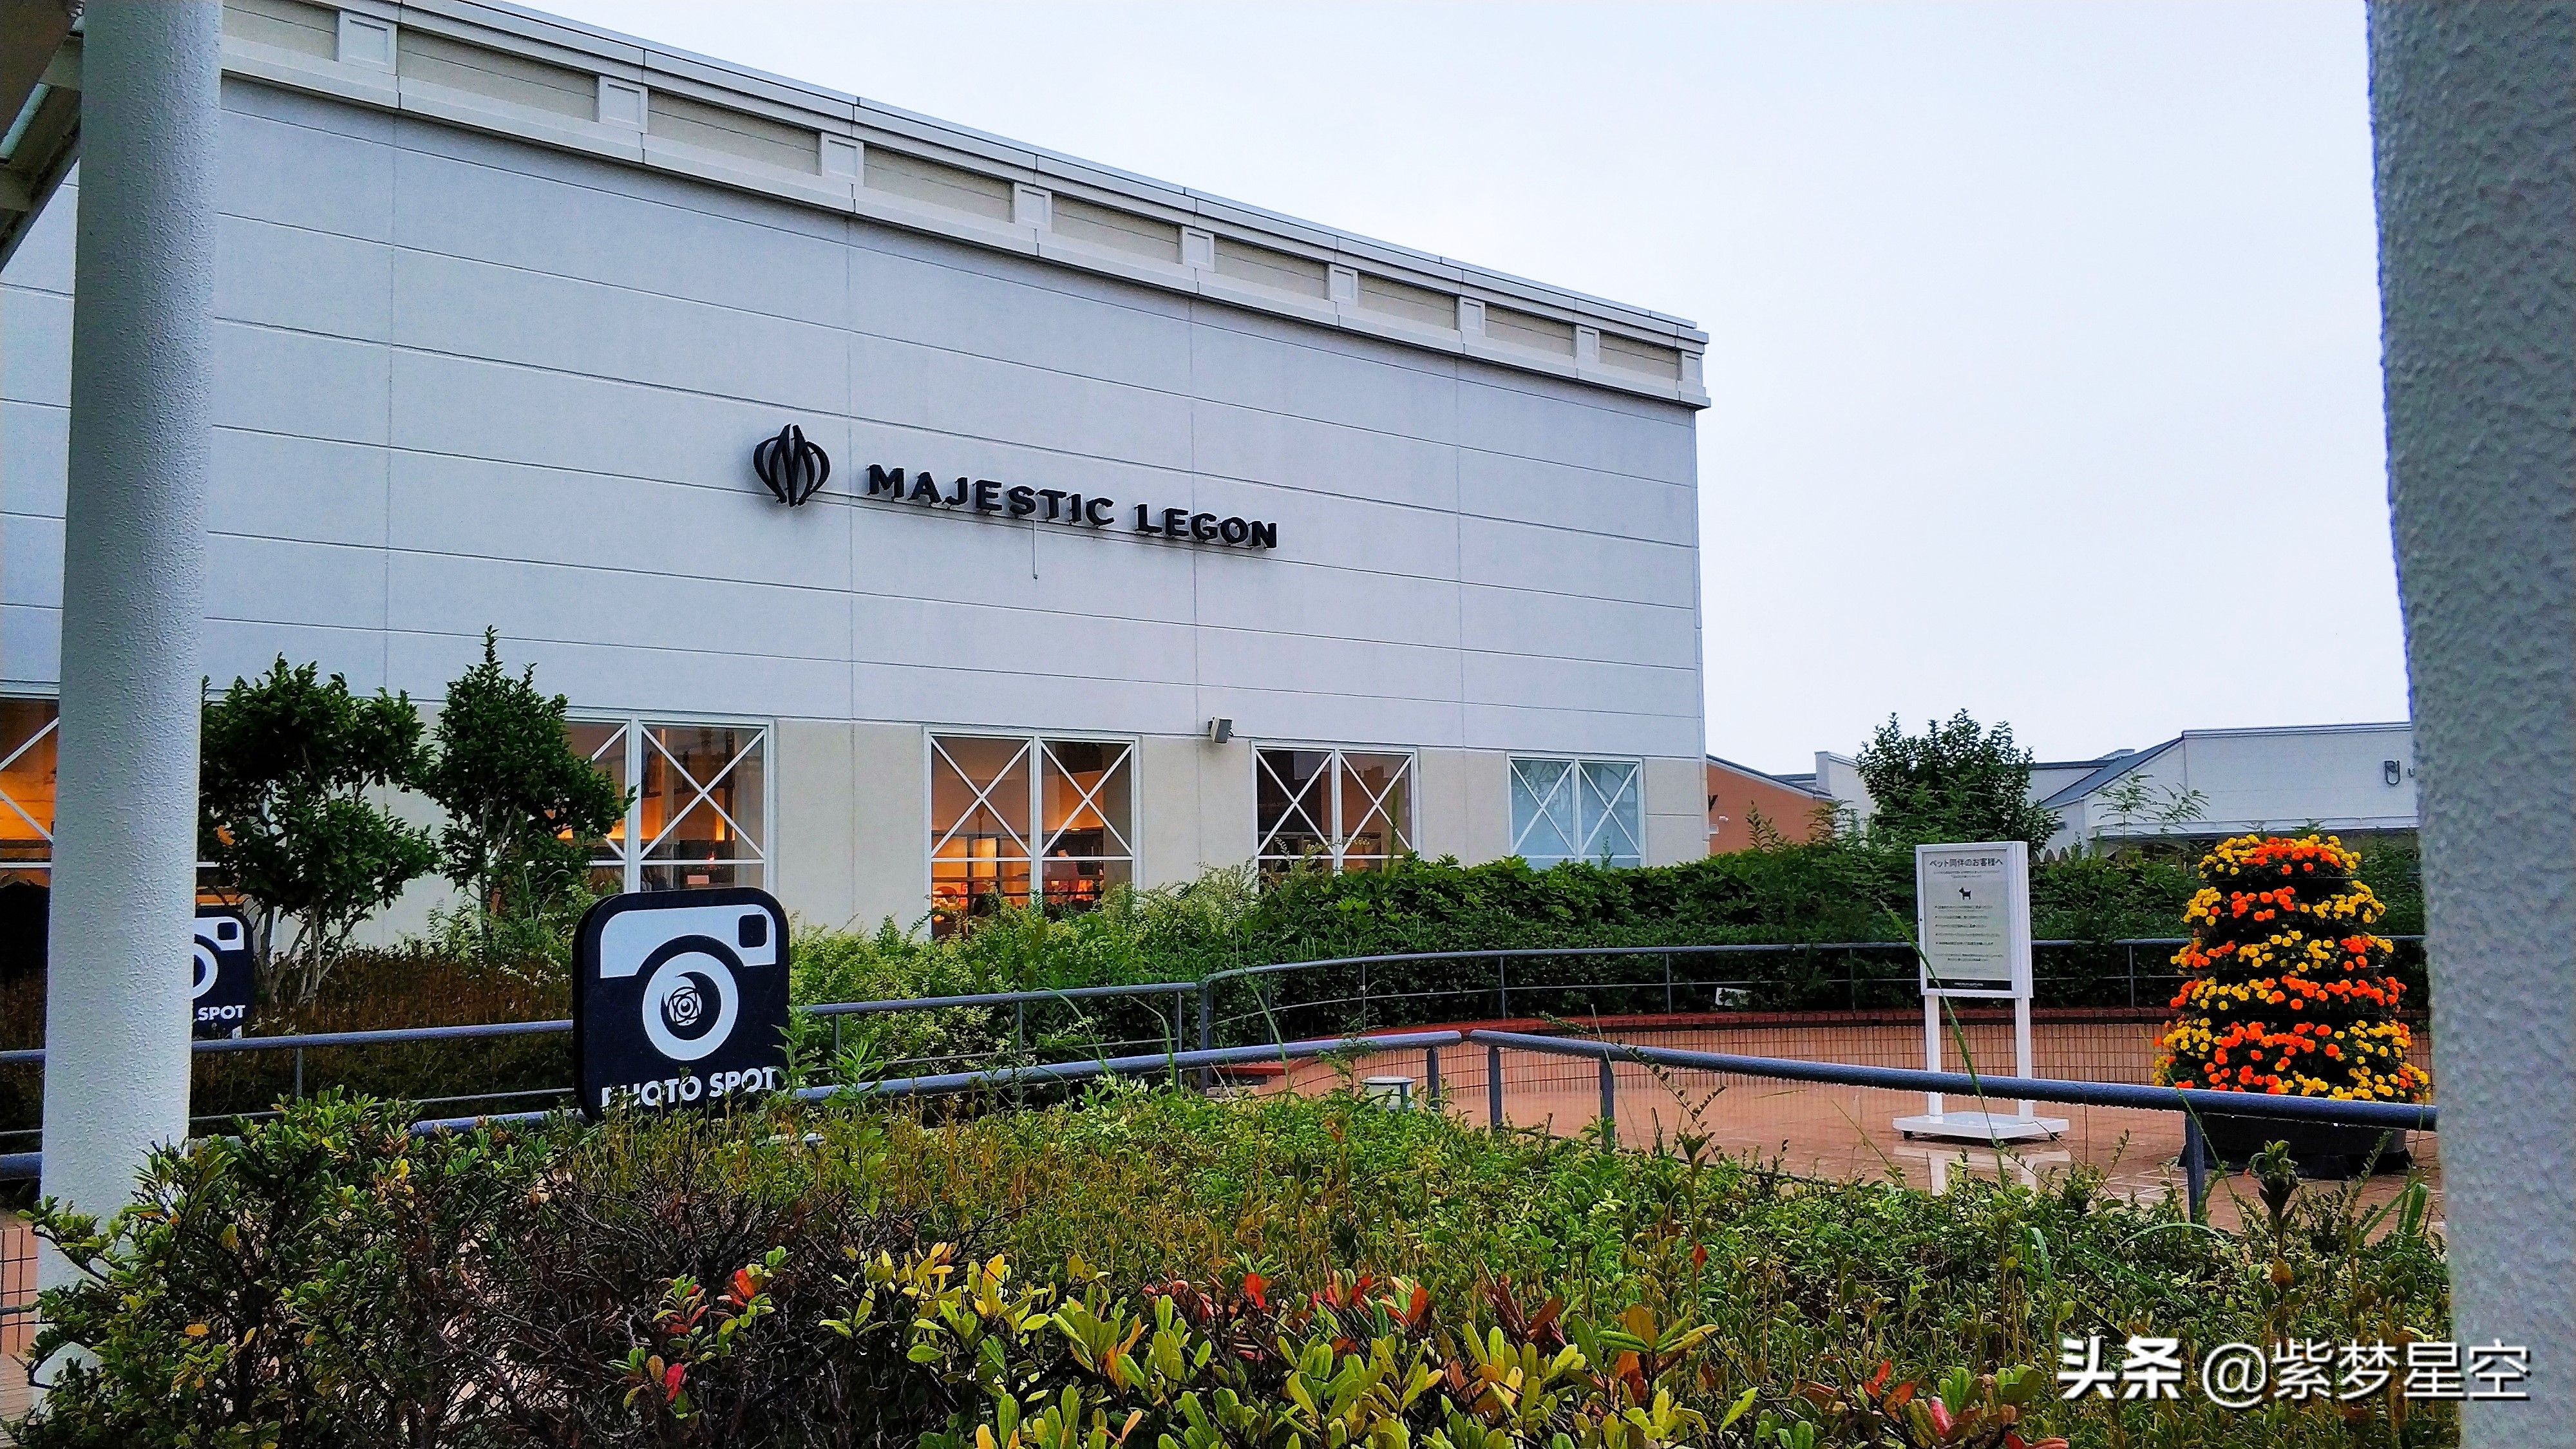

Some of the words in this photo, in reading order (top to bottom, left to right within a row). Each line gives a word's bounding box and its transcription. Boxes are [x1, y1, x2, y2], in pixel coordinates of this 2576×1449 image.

[867, 464, 1115, 526] MAJESTIC
[1135, 504, 1278, 549] LEGON
[198, 1005, 246, 1021] SPOT
[709, 1066, 776, 1097] SPOT
